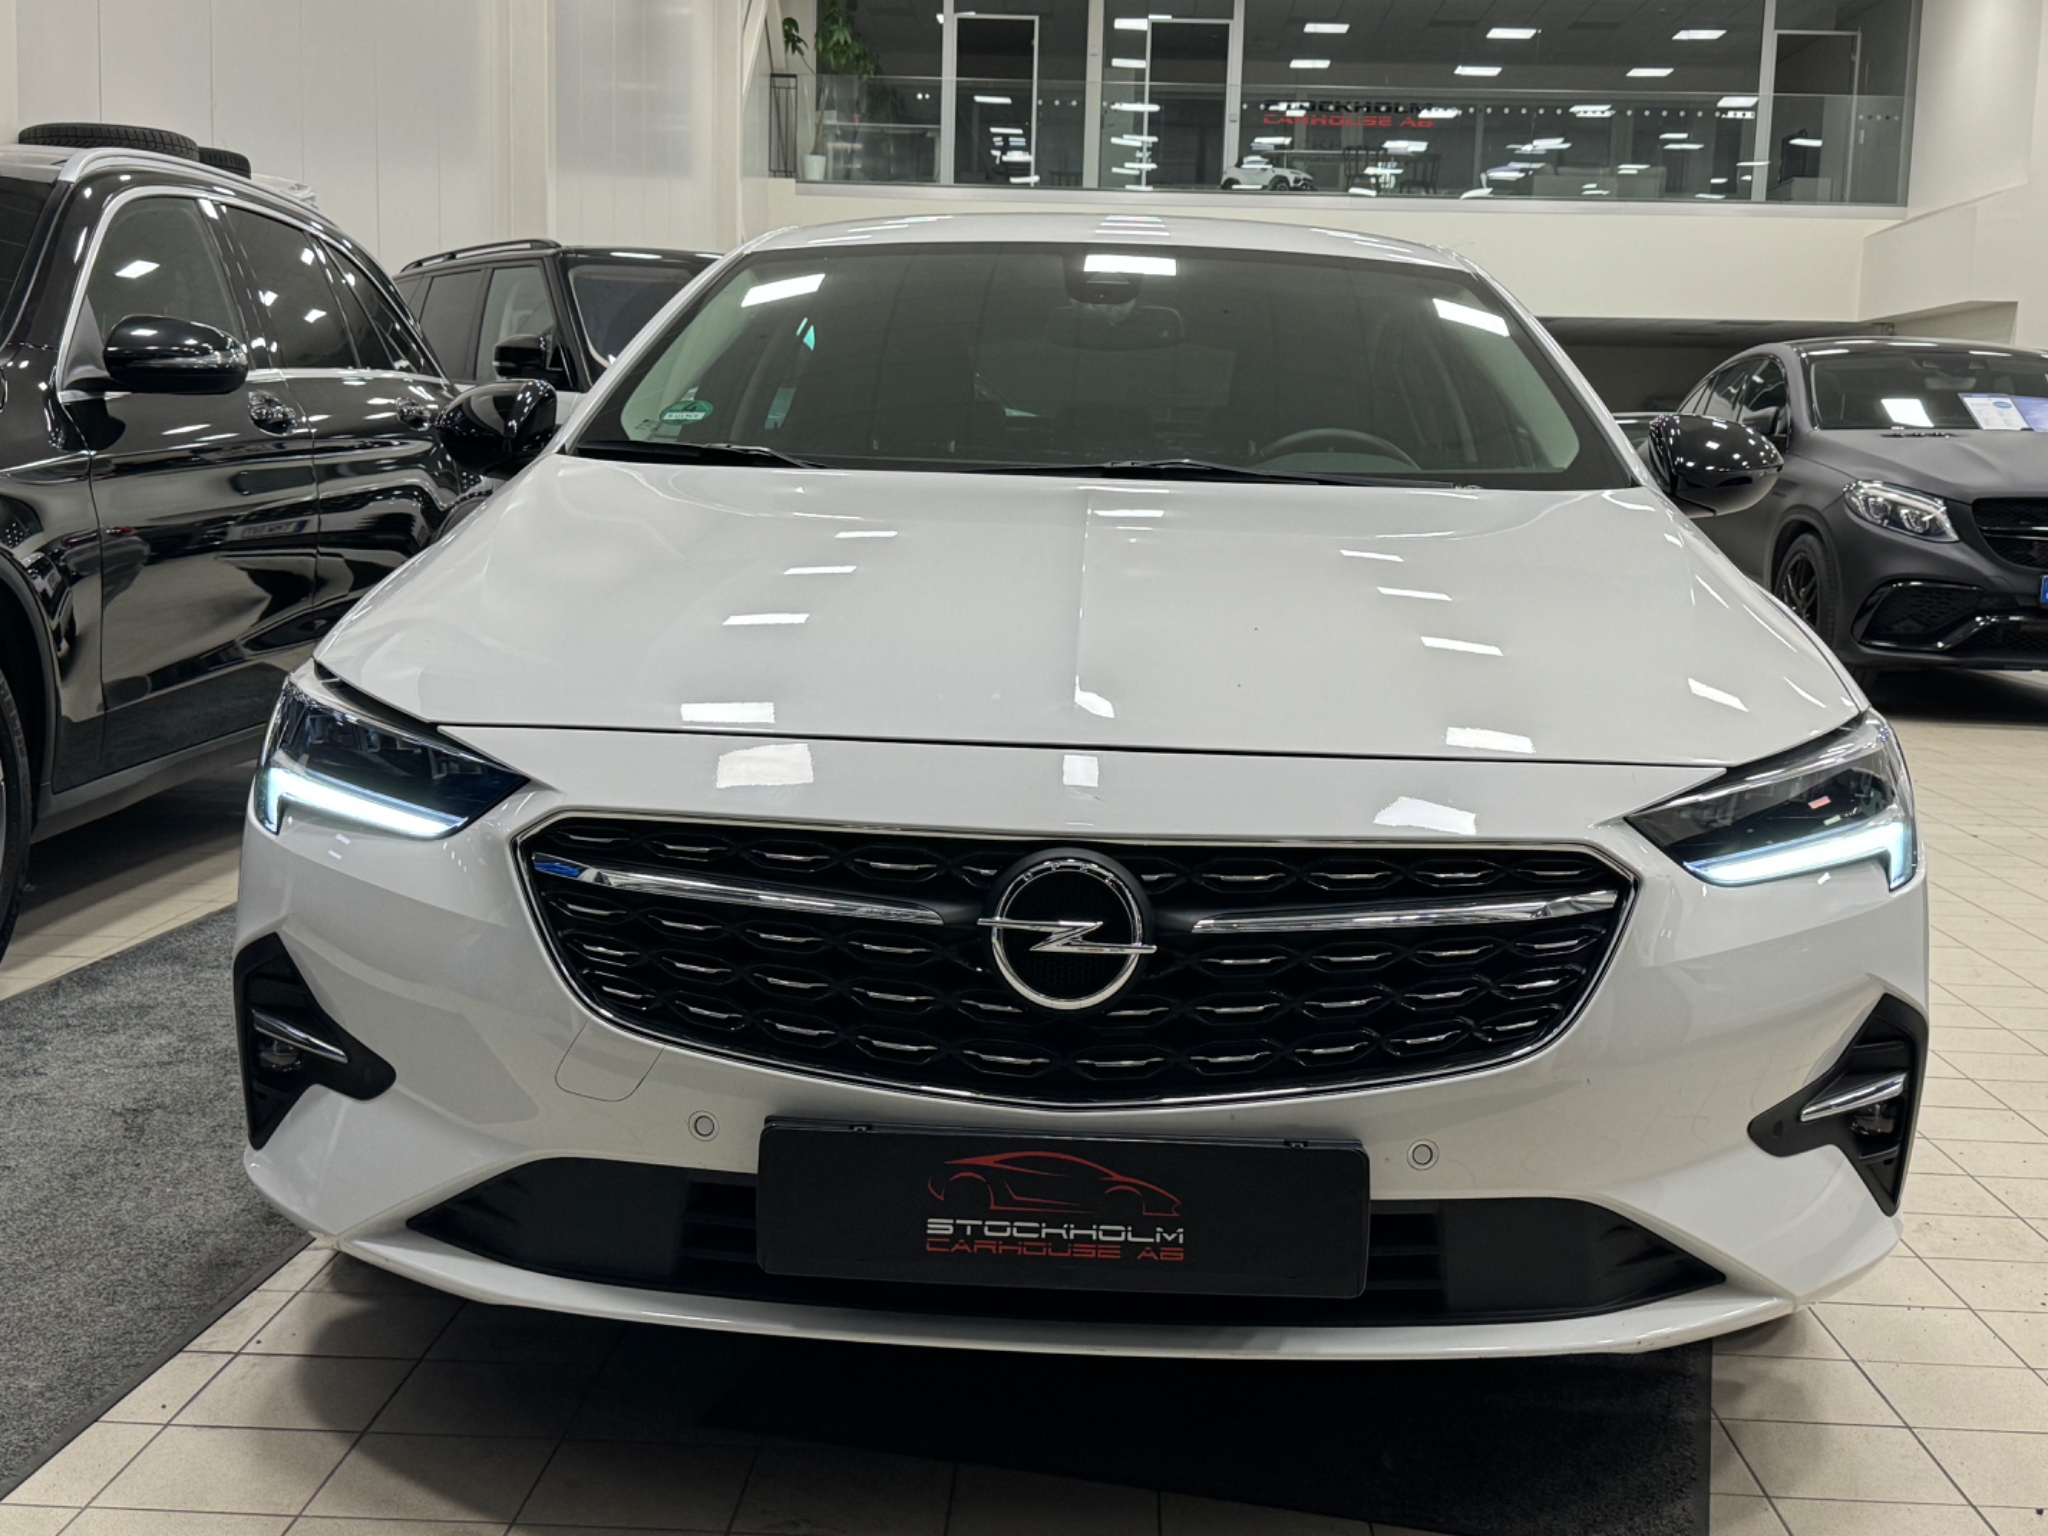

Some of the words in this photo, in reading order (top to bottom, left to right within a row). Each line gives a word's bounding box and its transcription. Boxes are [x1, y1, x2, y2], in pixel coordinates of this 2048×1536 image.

[1263, 113, 1392, 127] CARHOUSE
[1399, 116, 1434, 128] AB
[926, 1218, 1184, 1244] STOCKHOLM
[926, 1238, 1121, 1259] CARHOUSE
[1137, 1246, 1184, 1261] AB
